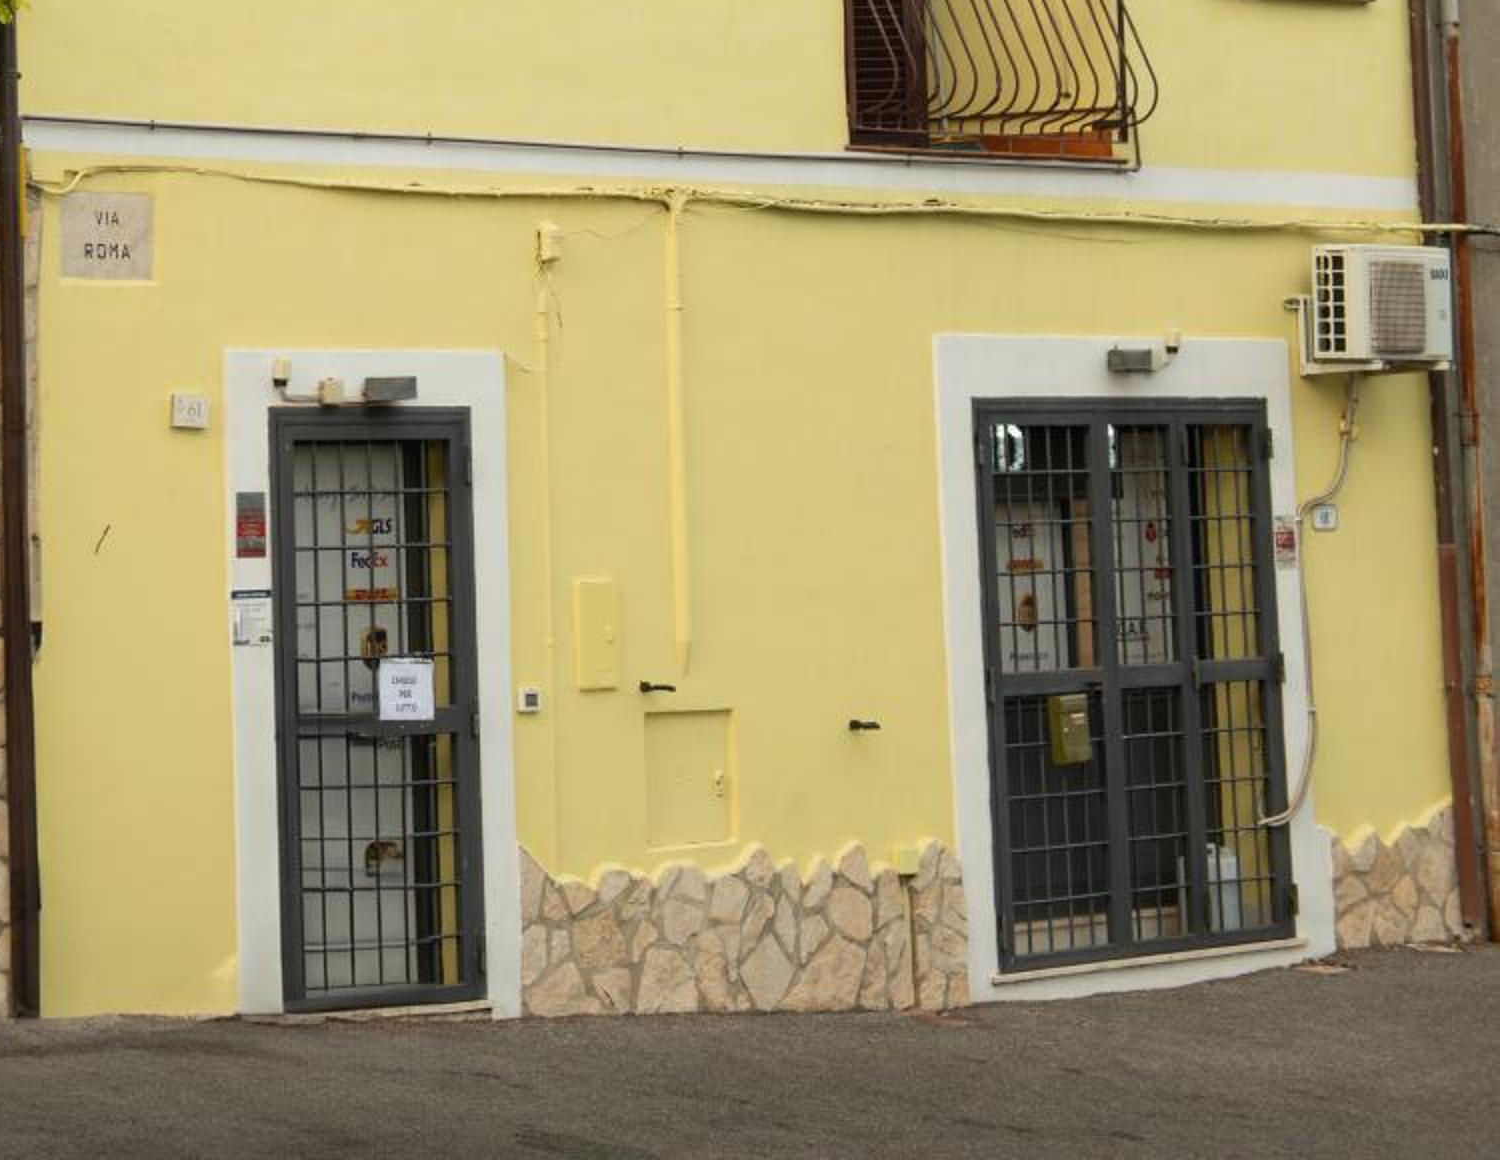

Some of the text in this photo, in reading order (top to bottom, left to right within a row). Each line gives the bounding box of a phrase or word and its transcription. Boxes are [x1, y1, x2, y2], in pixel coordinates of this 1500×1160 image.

[95, 211, 120, 225] VIA
[84, 243, 131, 260] ROMA
[351, 551, 389, 568] FedEx
